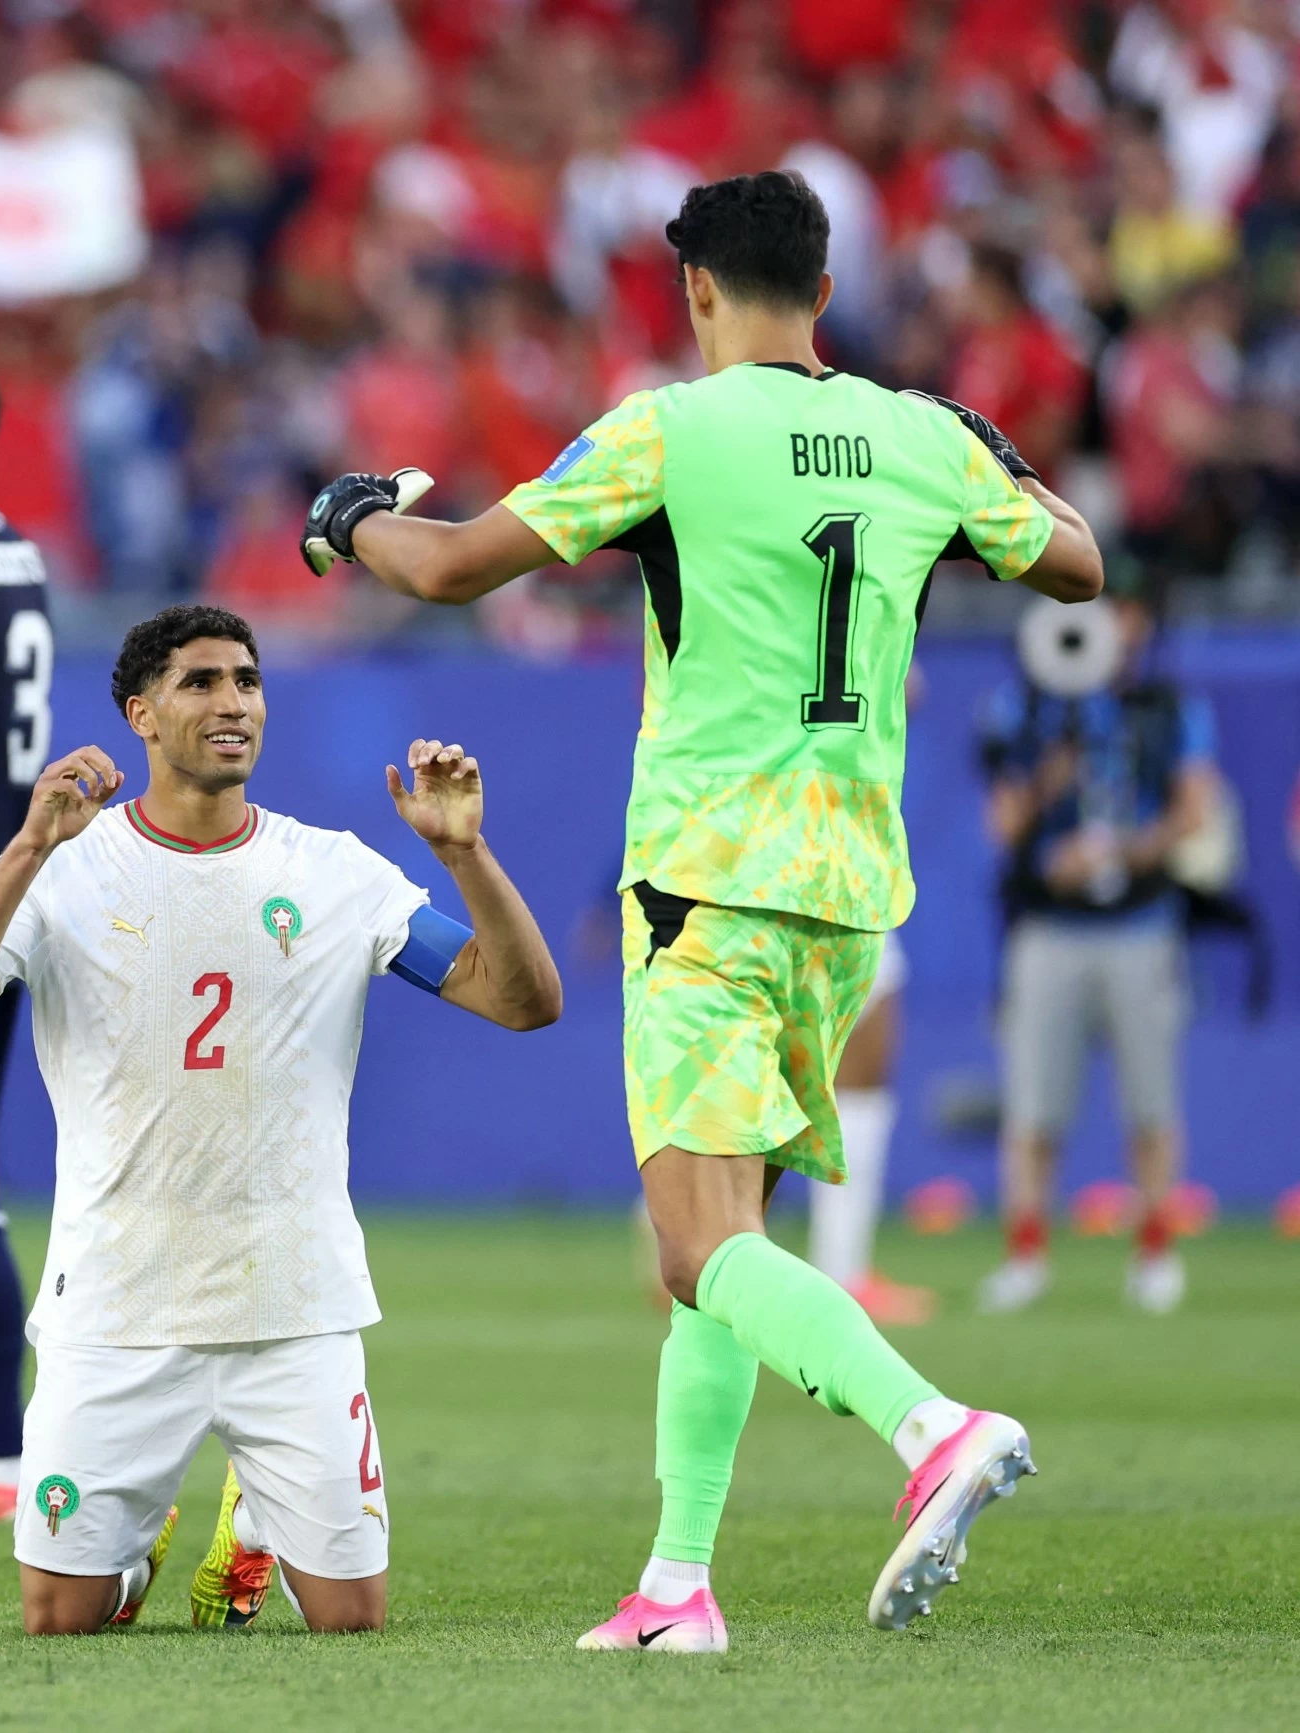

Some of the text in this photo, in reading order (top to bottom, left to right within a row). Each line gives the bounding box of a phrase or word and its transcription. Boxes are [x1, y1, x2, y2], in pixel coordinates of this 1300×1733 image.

[790, 433, 872, 478] BONO
[800, 512, 872, 733] 1
[6, 610, 54, 786] 3
[184, 972, 233, 1071] 2
[350, 1392, 382, 1494] 2
